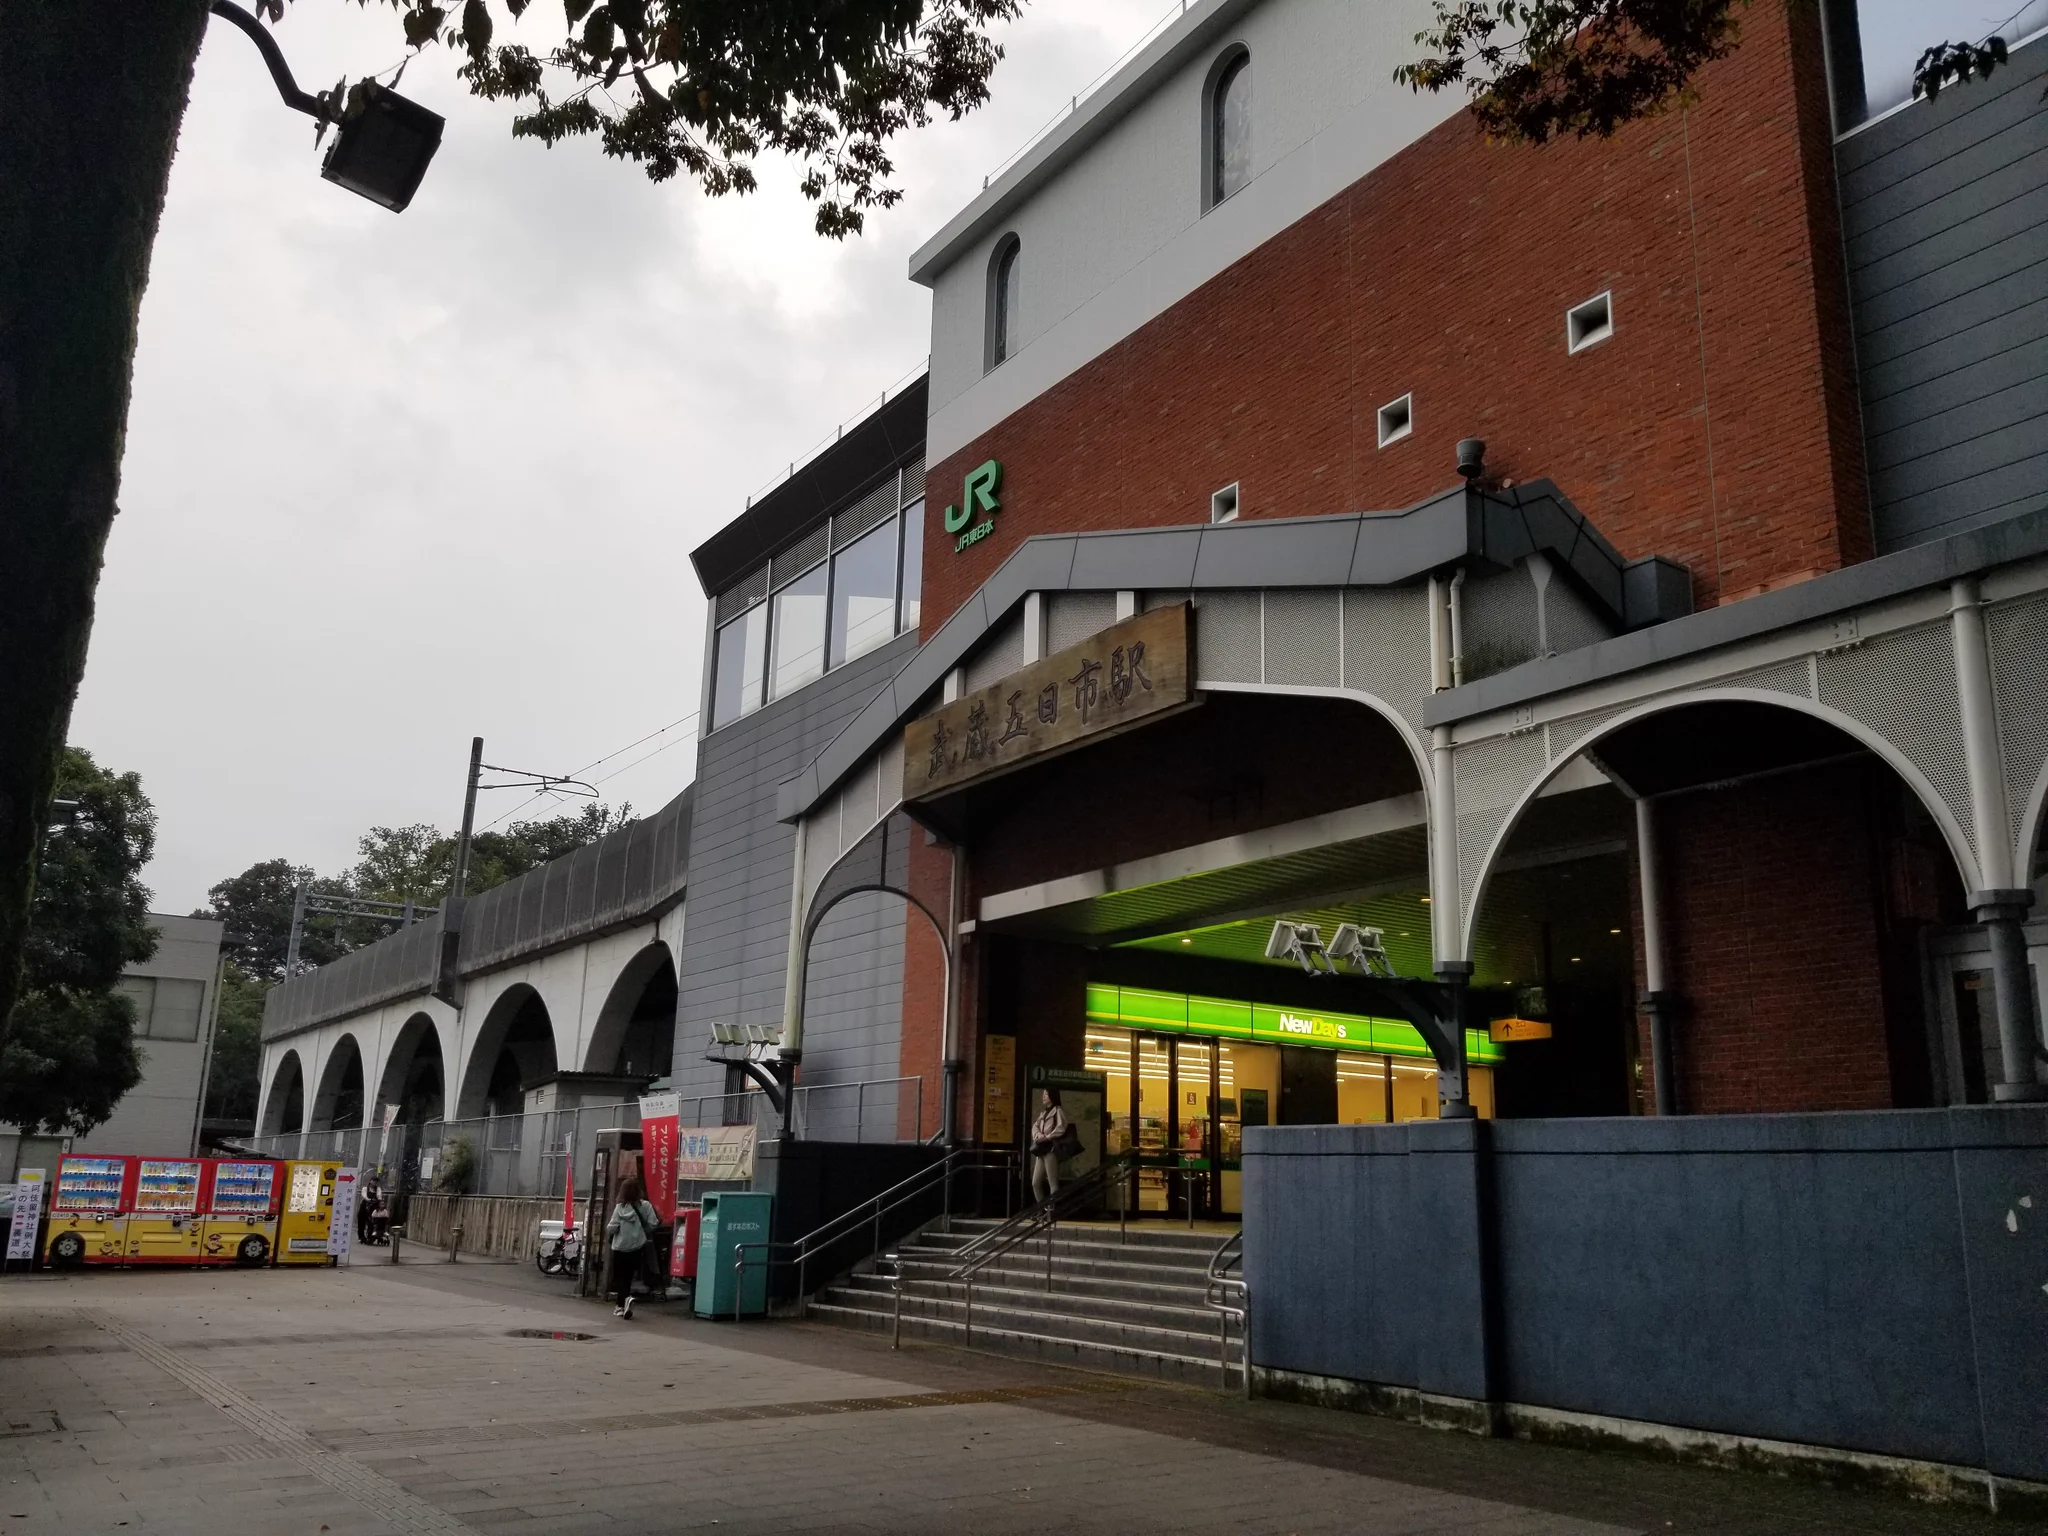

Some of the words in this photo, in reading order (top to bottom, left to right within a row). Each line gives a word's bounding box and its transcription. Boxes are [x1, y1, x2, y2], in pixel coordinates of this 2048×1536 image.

[945, 459, 1000, 534] JR
[955, 519, 994, 553] JR東日本
[927, 640, 1154, 780] 武蔵五日市駅
[1279, 1013, 1347, 1038] NewDays
[17, 1185, 28, 1213] この先
[21, 1184, 41, 1258] 阿伎留神社例大祭
